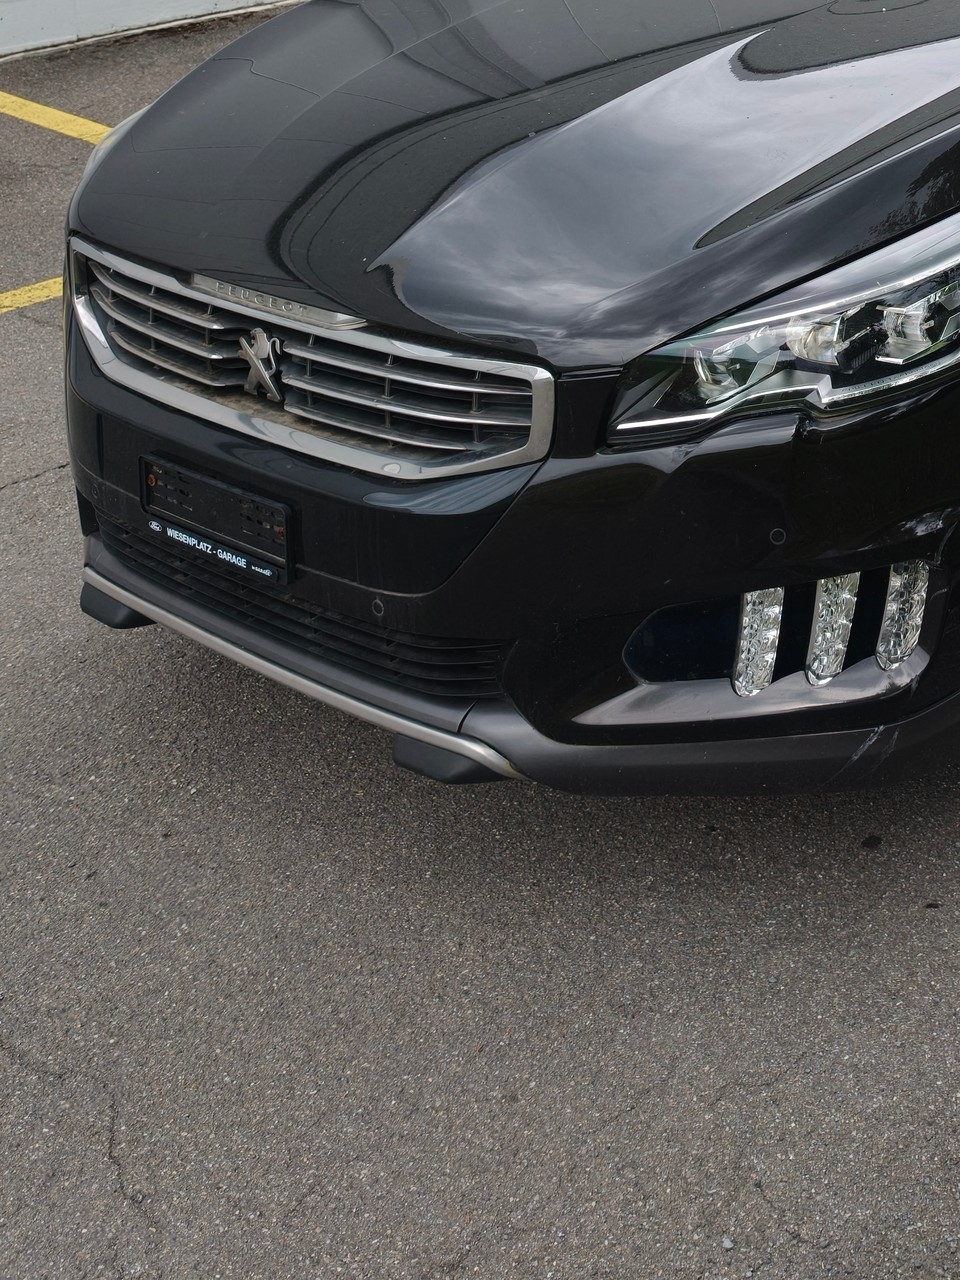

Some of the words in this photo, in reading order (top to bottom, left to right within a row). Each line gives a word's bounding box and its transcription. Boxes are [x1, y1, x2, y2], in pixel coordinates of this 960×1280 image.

[214, 281, 308, 317] PEUGEOT
[166, 527, 213, 554] WIESENPLATZ
[217, 549, 247, 568] GARAGE
